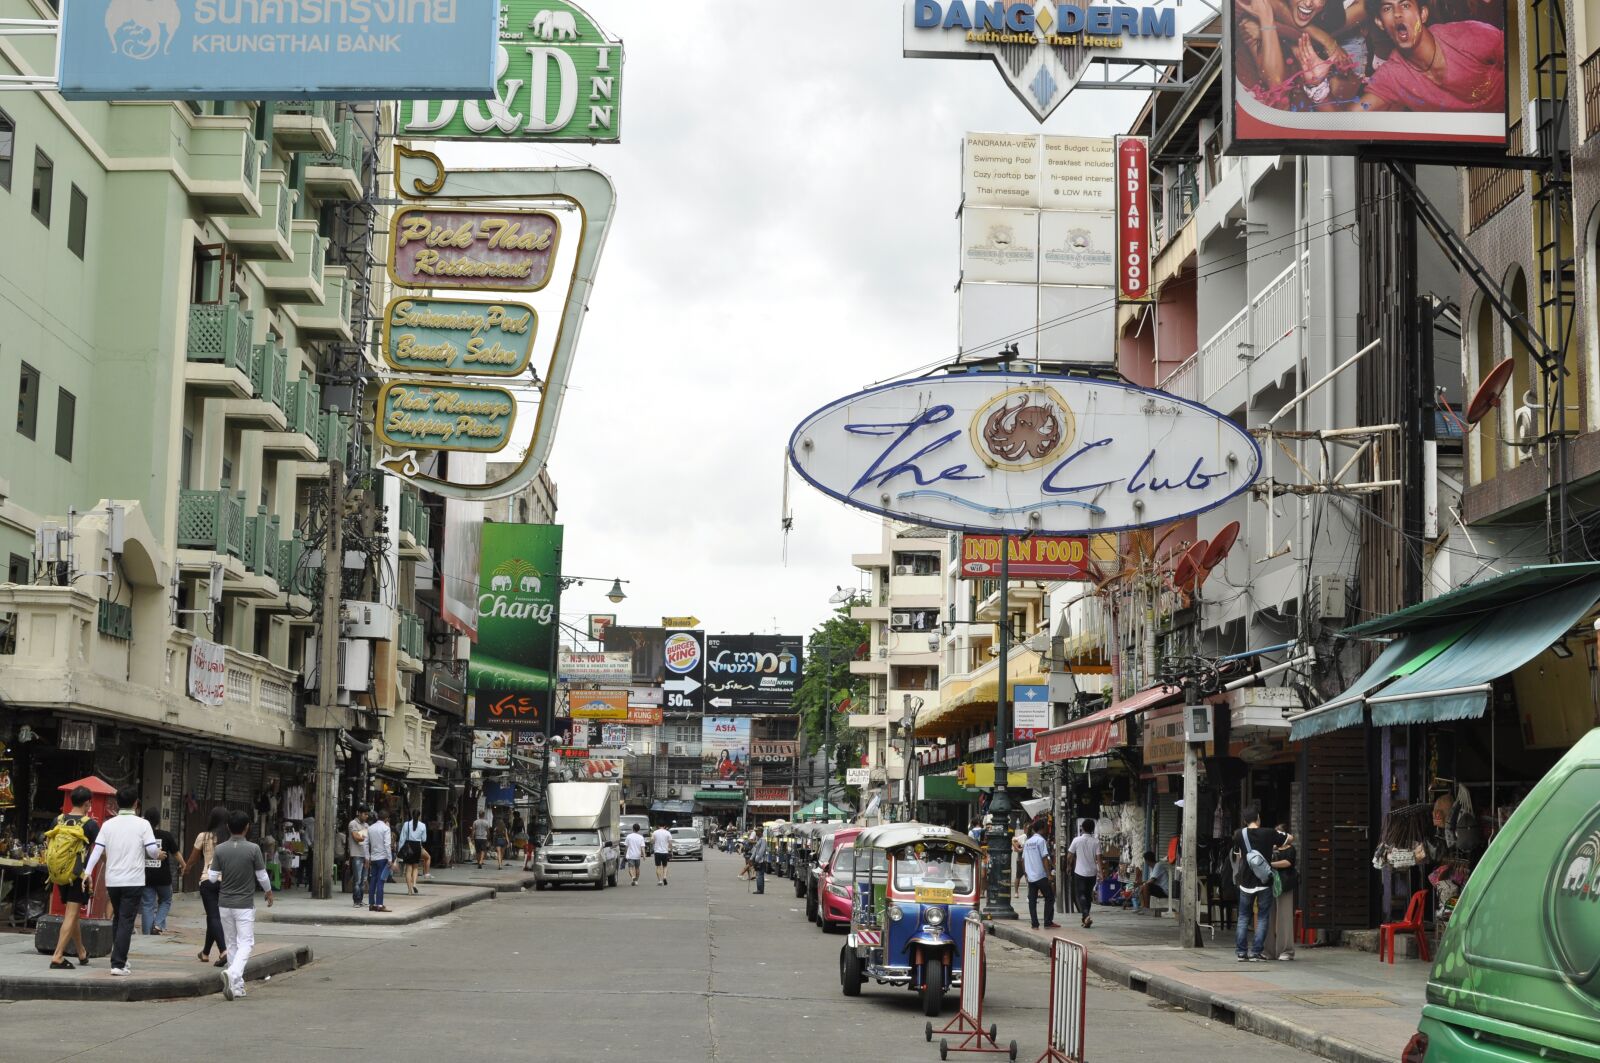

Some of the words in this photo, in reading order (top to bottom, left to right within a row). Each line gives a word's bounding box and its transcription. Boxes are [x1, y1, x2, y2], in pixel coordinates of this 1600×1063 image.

[914, 0, 1034, 33] DANG
[1058, 3, 1175, 38] DERM
[192, 34, 330, 53] KRUNGTHAI
[336, 34, 402, 53] BANK
[966, 31, 1038, 45] Authentic
[1045, 34, 1076, 47] Thai
[1083, 36, 1123, 49] Hotel
[588, 47, 614, 130] INN
[967, 139, 1036, 149] PANORAMA-VIEW
[1045, 143, 1061, 151] Best
[1064, 145, 1089, 153] Budget
[974, 155, 1013, 165] Swimming
[1015, 156, 1032, 164] Pool
[1048, 158, 1081, 166] Breakfast
[1084, 160, 1114, 168] included
[973, 170, 991, 179] Cozy
[994, 171, 1022, 181] rooftop
[1024, 172, 1037, 180] bar
[1050, 174, 1083, 183] hi-speed
[977, 186, 993, 195] Thai
[995, 188, 1030, 197] message
[1062, 188, 1080, 197] LOW
[1083, 190, 1103, 198] RATE
[1127, 156, 1140, 229] INDIAN
[400, 217, 552, 250] Pick-Thai
[413, 250, 533, 279] Restaurant
[1128, 241, 1141, 291] FOOD
[391, 301, 485, 338] Swimming
[484, 305, 531, 335] Pool
[396, 334, 458, 367] Beauty
[463, 337, 517, 365] Salon
[390, 387, 431, 412] Thai
[432, 390, 511, 422] Massage
[386, 410, 455, 443] Shopping
[844, 404, 985, 498] The
[1040, 437, 1227, 496] Club
[1036, 539, 1084, 564] FOOD
[478, 593, 554, 626] Chang
[667, 640, 695, 655] BURGER
[570, 654, 585, 663] N.S.
[587, 654, 606, 663] TOUR
[668, 649, 696, 664] KING
[668, 693, 694, 708] 50m.
[715, 724, 737, 732] ASIA
[753, 744, 793, 754] INDIAN
[758, 754, 787, 762] FOOD
